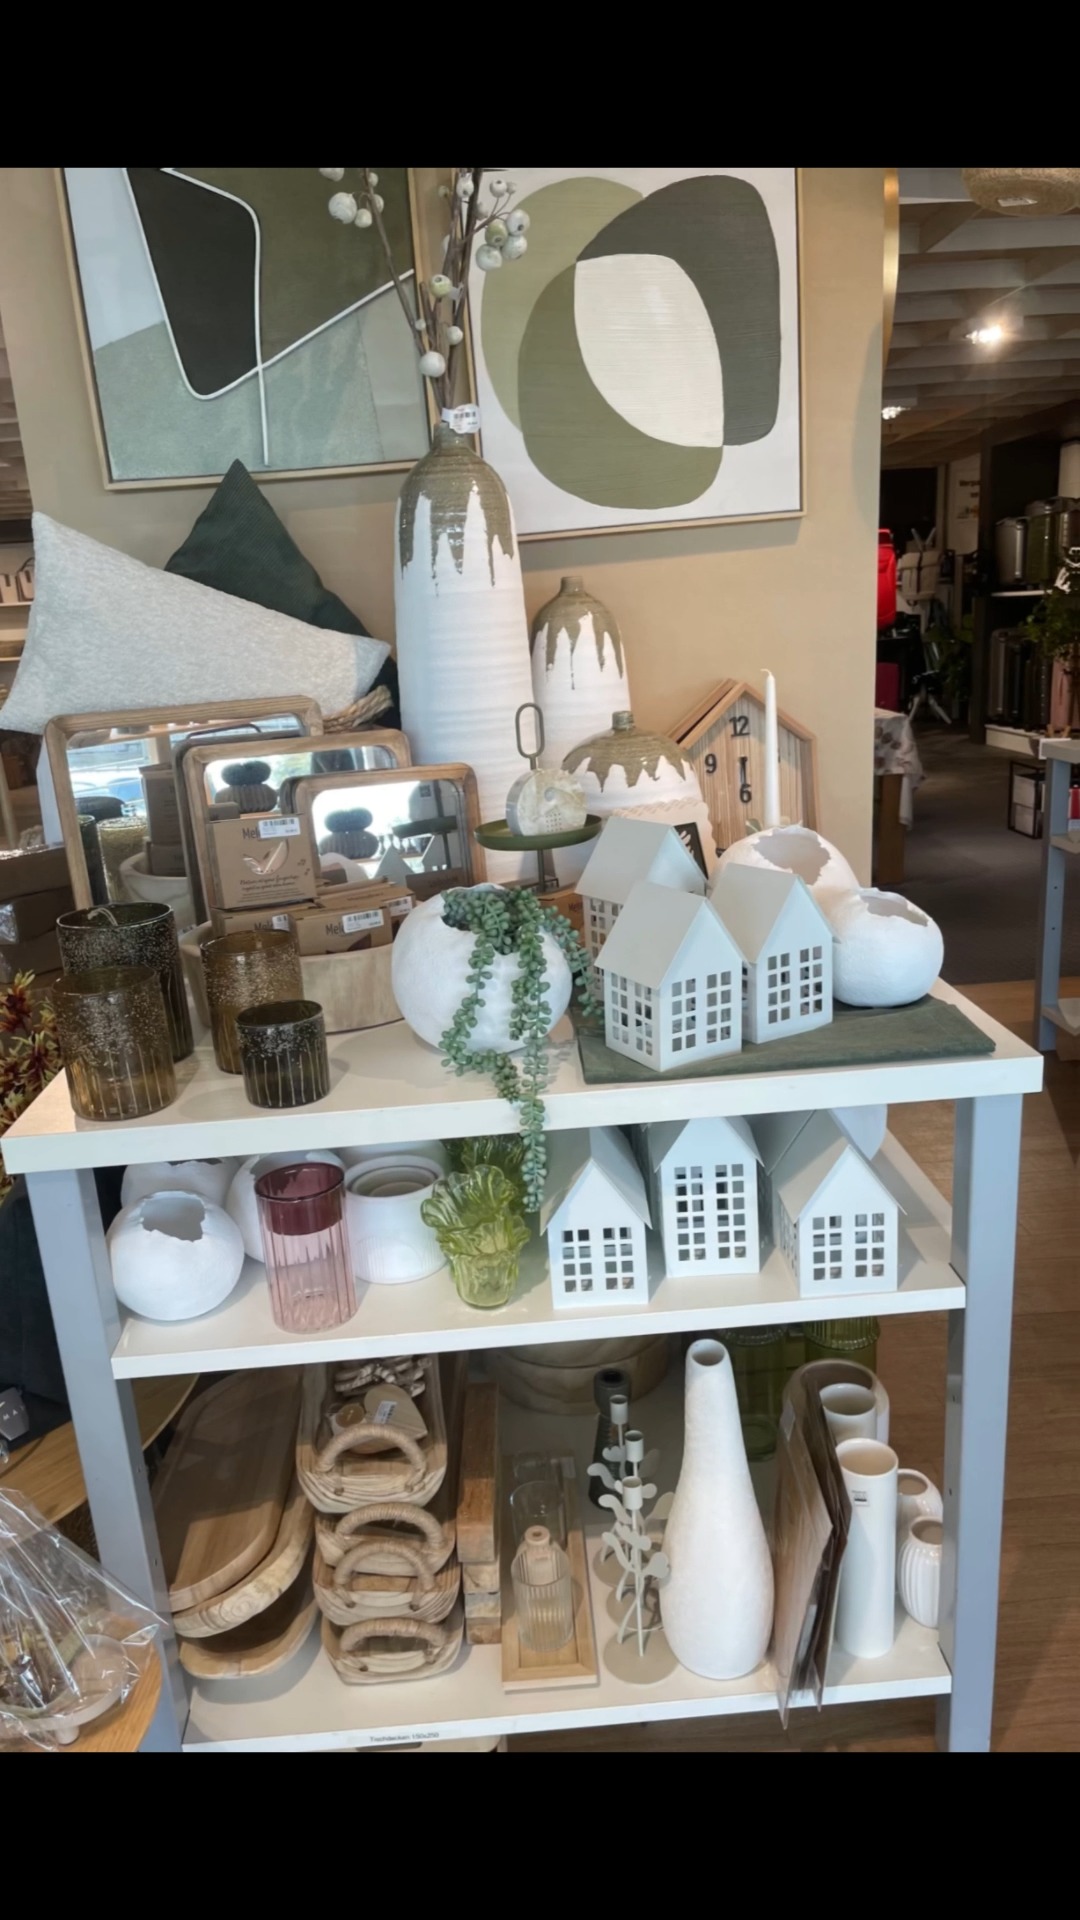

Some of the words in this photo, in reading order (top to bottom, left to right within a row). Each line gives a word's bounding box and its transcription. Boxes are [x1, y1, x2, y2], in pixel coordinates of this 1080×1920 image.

[729, 715, 750, 737] 12
[705, 753, 717, 774] 9
[740, 784, 752, 804] 6
